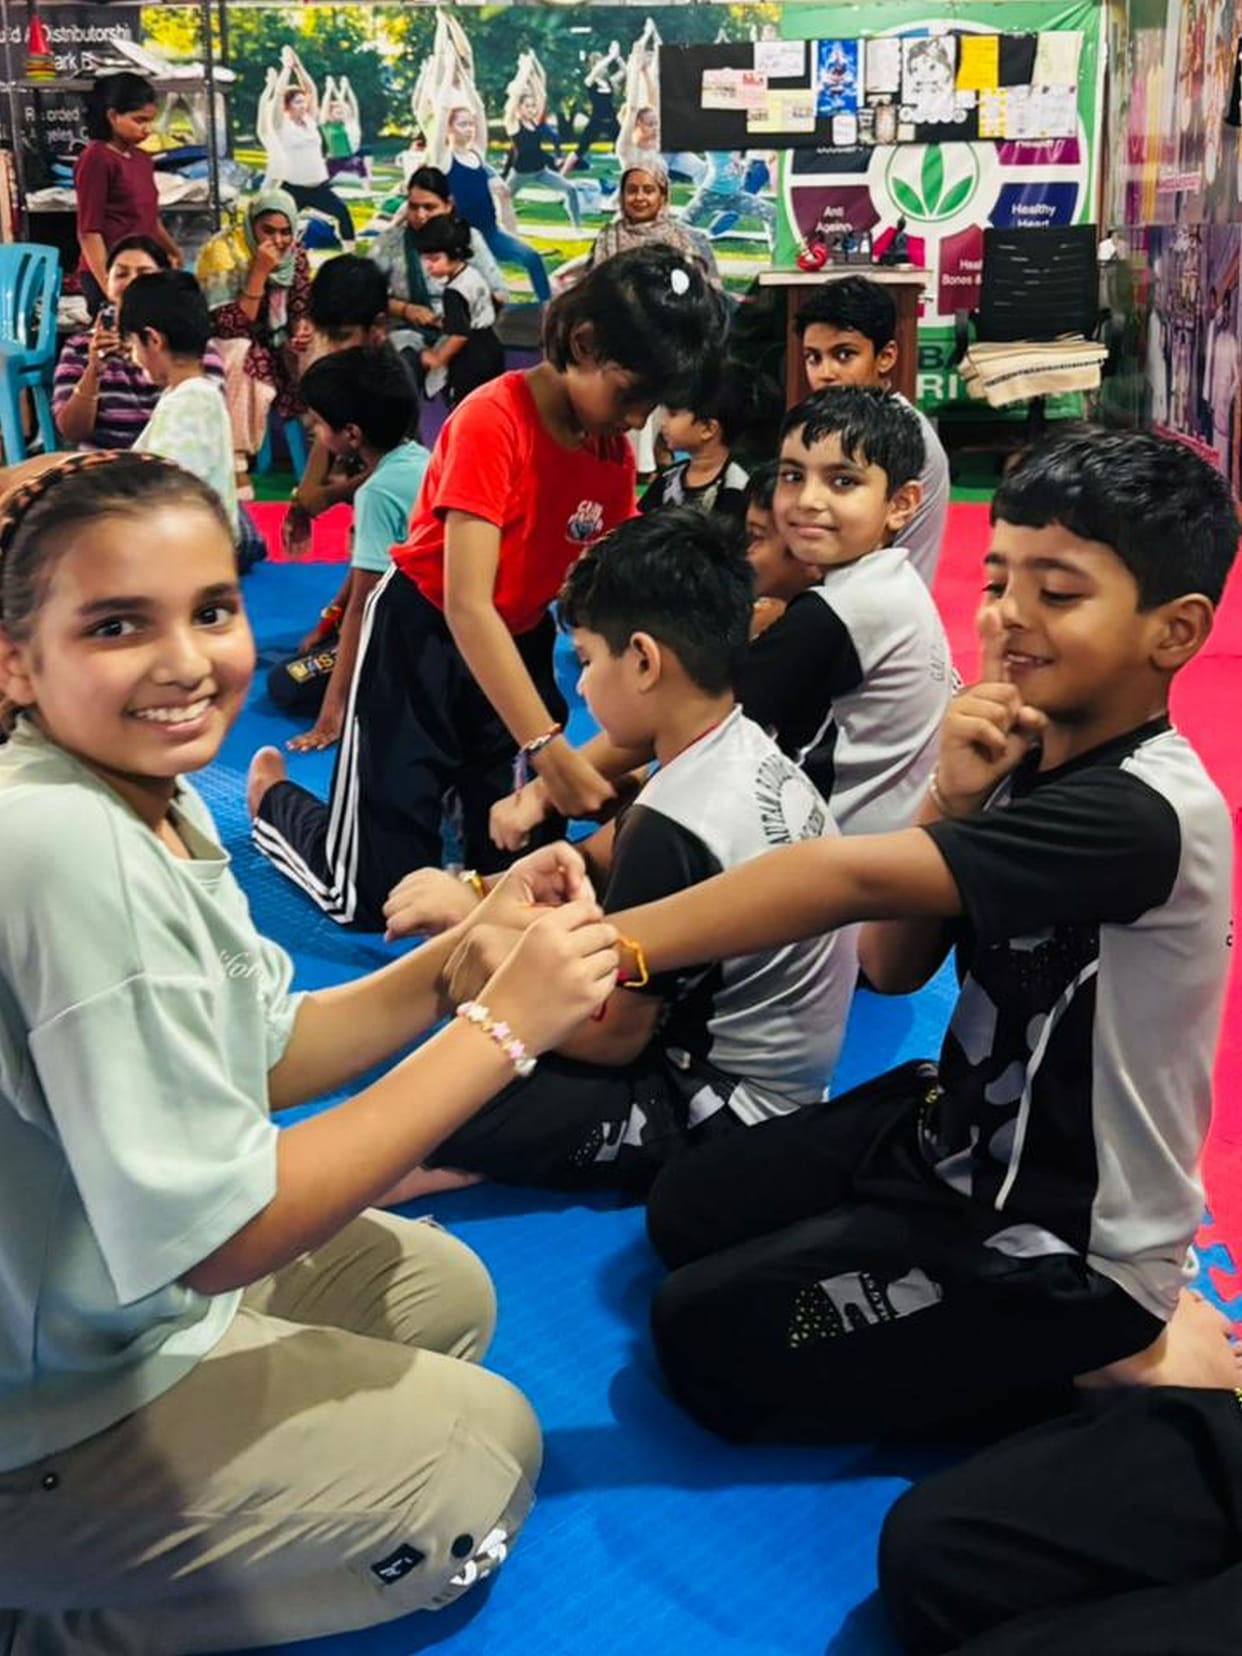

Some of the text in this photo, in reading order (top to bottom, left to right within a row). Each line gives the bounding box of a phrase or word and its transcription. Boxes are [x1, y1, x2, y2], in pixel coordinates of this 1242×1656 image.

[1011, 203, 1056, 217] Healthy
[959, 259, 983, 270] Heal
[941, 273, 972, 286] Bones
